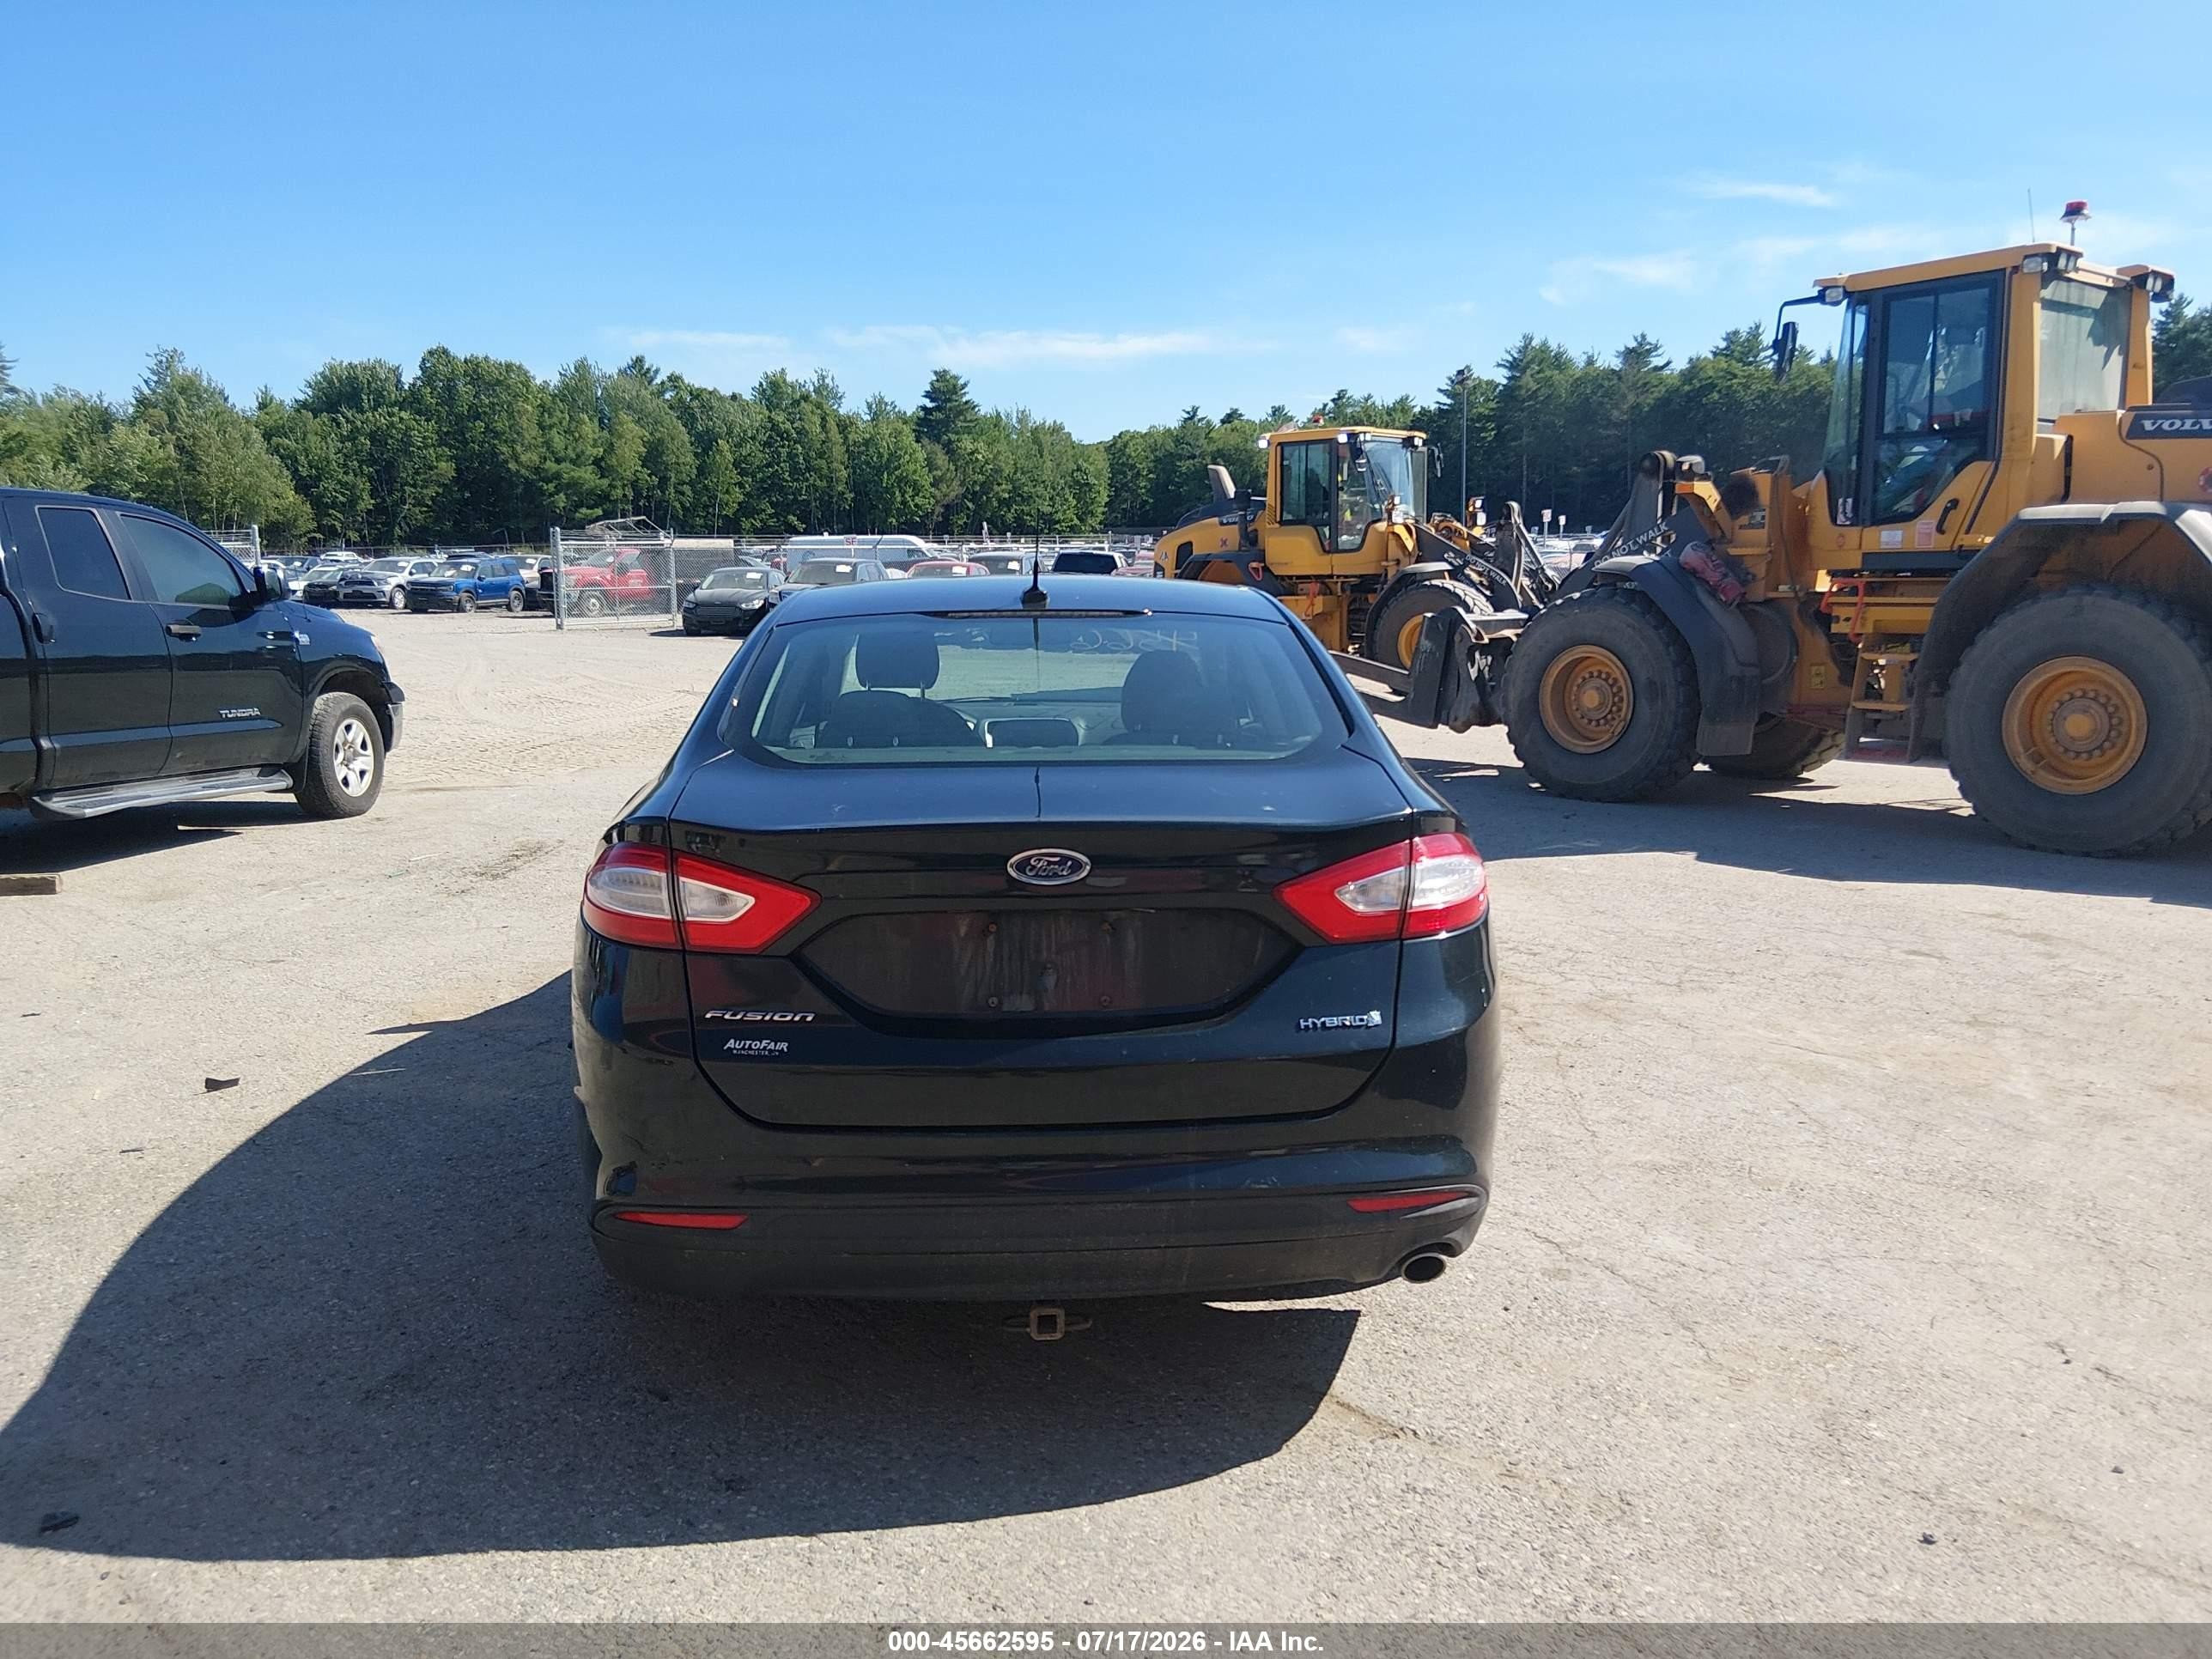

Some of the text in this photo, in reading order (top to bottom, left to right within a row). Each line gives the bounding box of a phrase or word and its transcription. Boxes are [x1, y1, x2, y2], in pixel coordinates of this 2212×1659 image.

[1611, 539, 1636, 558] NOT
[1636, 521, 1668, 545] WALK
[219, 707, 261, 719] TUNDRA
[1025, 856, 1073, 876] Ford
[704, 1010, 815, 1022] FUSION
[1299, 1015, 1368, 1030] HYBRID
